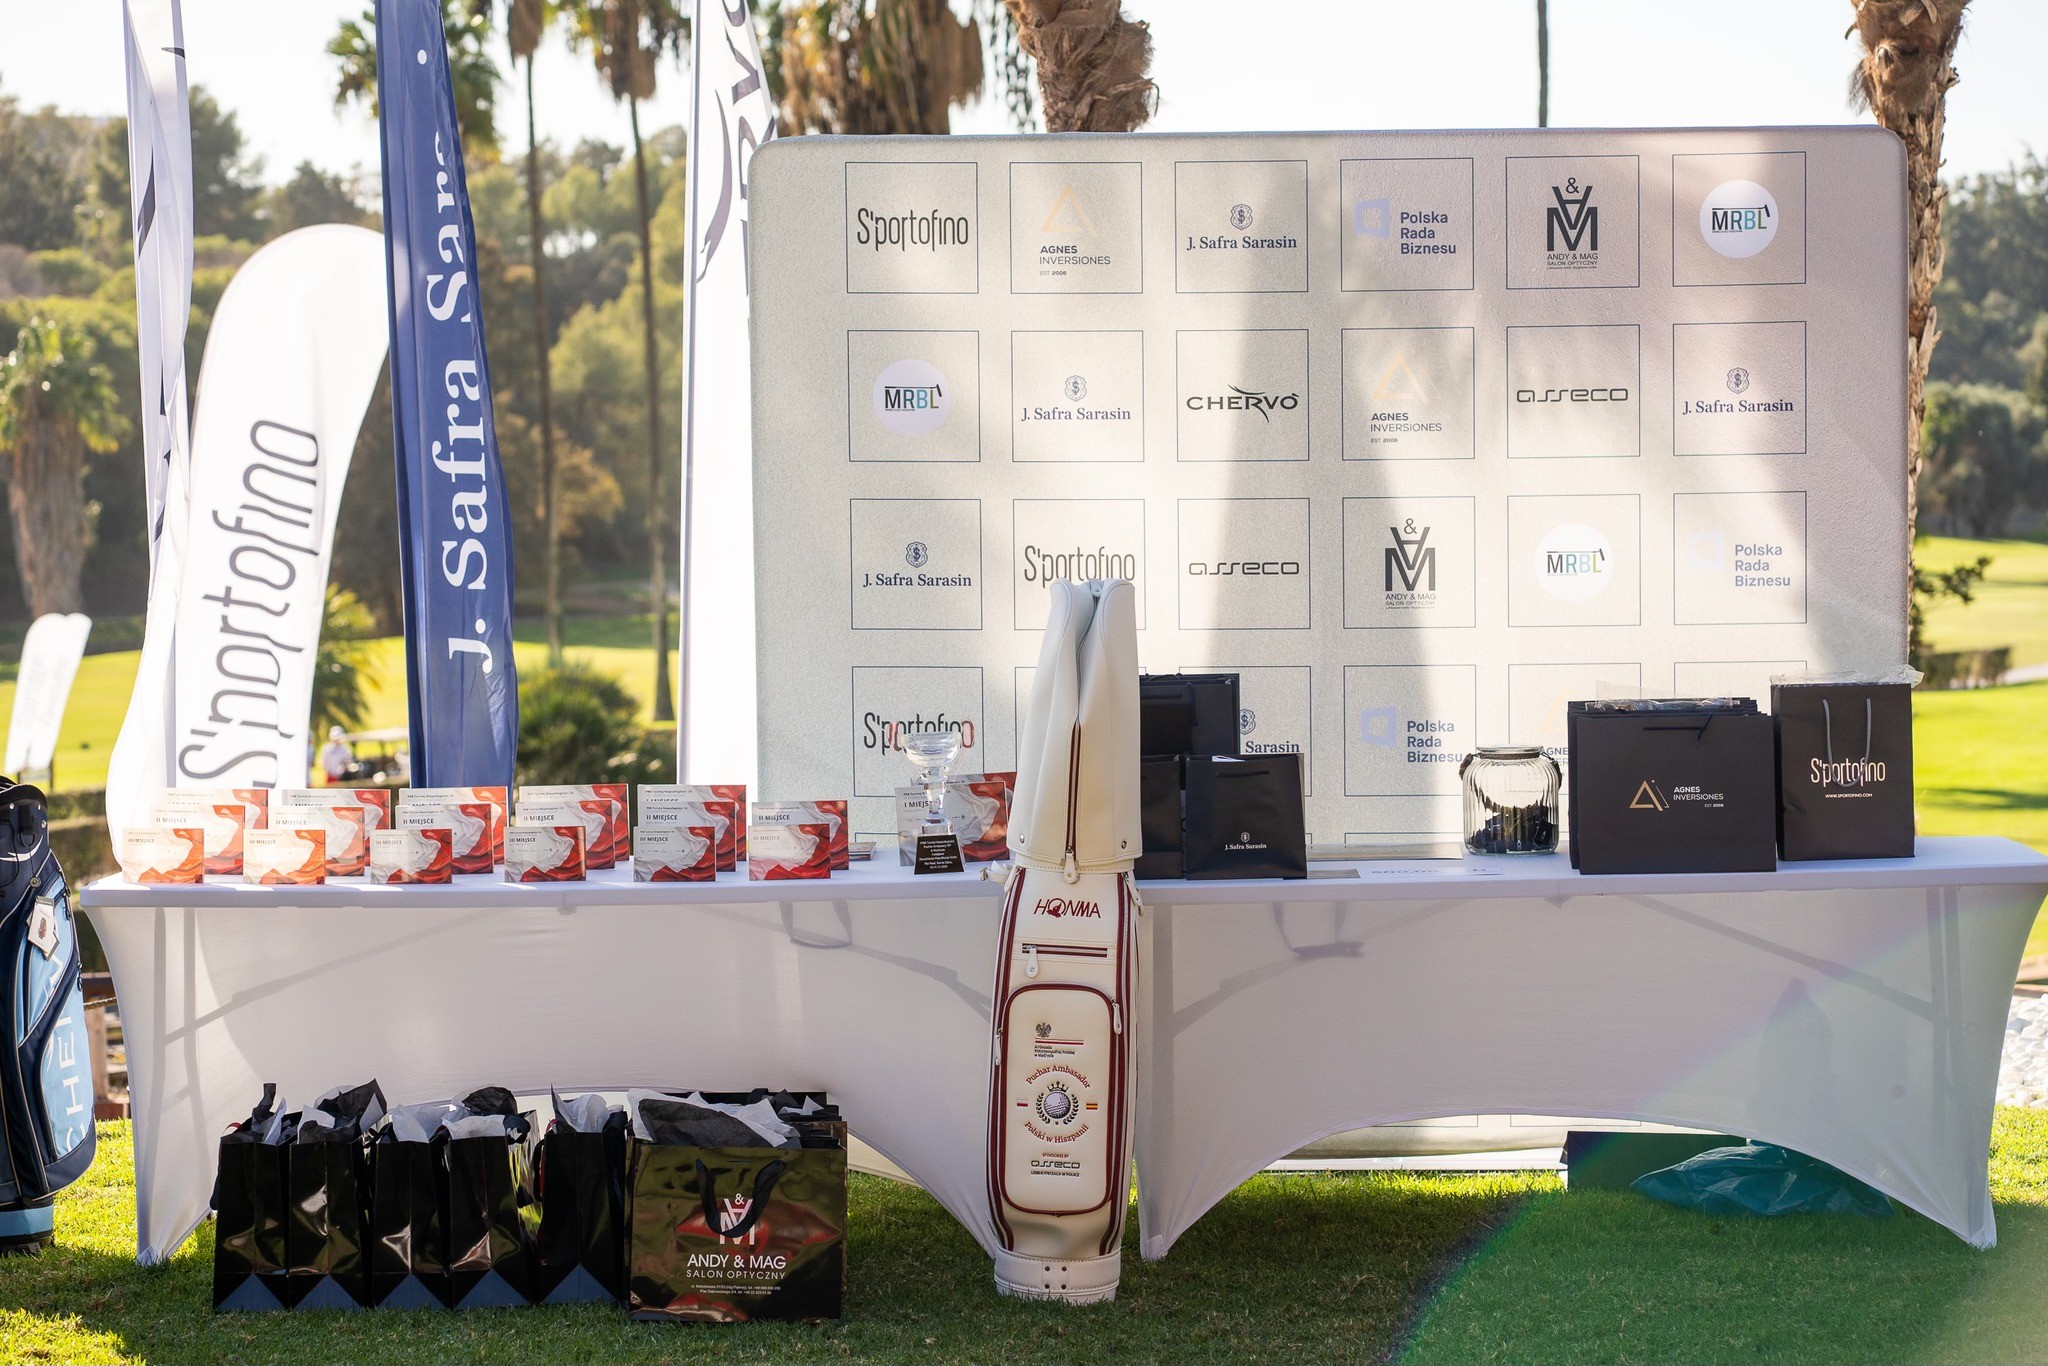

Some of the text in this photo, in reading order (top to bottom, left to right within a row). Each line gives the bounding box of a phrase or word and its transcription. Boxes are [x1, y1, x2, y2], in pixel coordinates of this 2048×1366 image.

[1400, 211, 1448, 224] Polska
[1712, 210, 1767, 230] MRBL
[857, 207, 969, 252] S'portofino
[1400, 227, 1436, 239] Rada
[1040, 245, 1078, 254] AGNES
[1187, 236, 1298, 250] J. Safra Sarasin
[1400, 242, 1456, 254] Biznesu
[1039, 256, 1111, 265] INVERSIONES
[885, 389, 939, 408] MRBL
[1516, 388, 1628, 403] asseco
[1682, 399, 1794, 414] J. Safra Sarasin
[1021, 407, 1131, 422] J. Safra Sarasin
[1371, 412, 1409, 421] AGNES
[1370, 423, 1442, 432] INVERSIONES
[432, 359, 488, 590] Safra
[1735, 544, 1782, 556] Polska
[1189, 561, 1300, 575] asseco
[1547, 554, 1602, 573] MRBL
[1735, 560, 1770, 572] Rada
[862, 573, 972, 588] J. Safra Sarasin
[1735, 575, 1791, 587] Biznesu
[448, 618, 492, 674] J.
[1407, 720, 1455, 733] Polska
[1246, 741, 1300, 754] Sarasin
[1407, 736, 1442, 748] Rada
[1407, 751, 1463, 763] Biznesu
[1810, 758, 1886, 787] S'portofino
[1034, 898, 1101, 918] HONMA
[1026, 1065, 1091, 1089] Puchar Ambasador
[1024, 1121, 1045, 1142] Polski
[1054, 1124, 1089, 1143] Hiszpanii
[1031, 1160, 1080, 1169] asseco
[687, 1254, 787, 1269] ANDY & MAG
[686, 1270, 786, 1280] SALON OPTYCZNY
